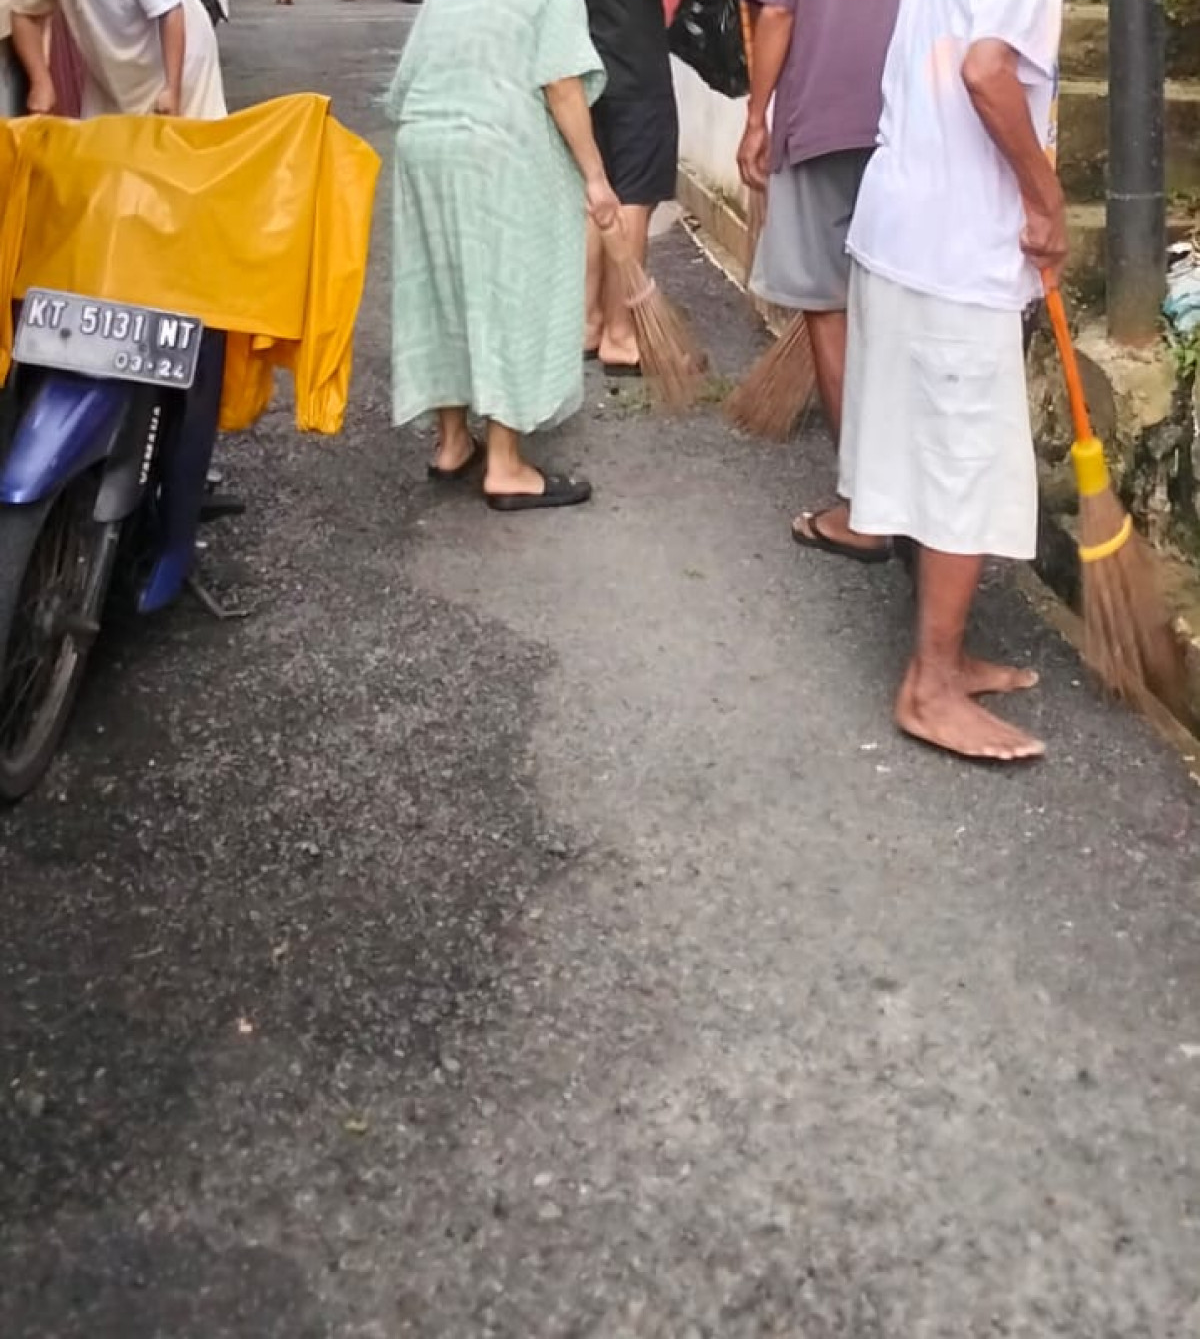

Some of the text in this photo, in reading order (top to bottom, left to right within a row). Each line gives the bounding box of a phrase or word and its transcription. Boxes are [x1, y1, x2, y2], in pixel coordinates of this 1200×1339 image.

[27, 297, 196, 349] KT 5131 NT
